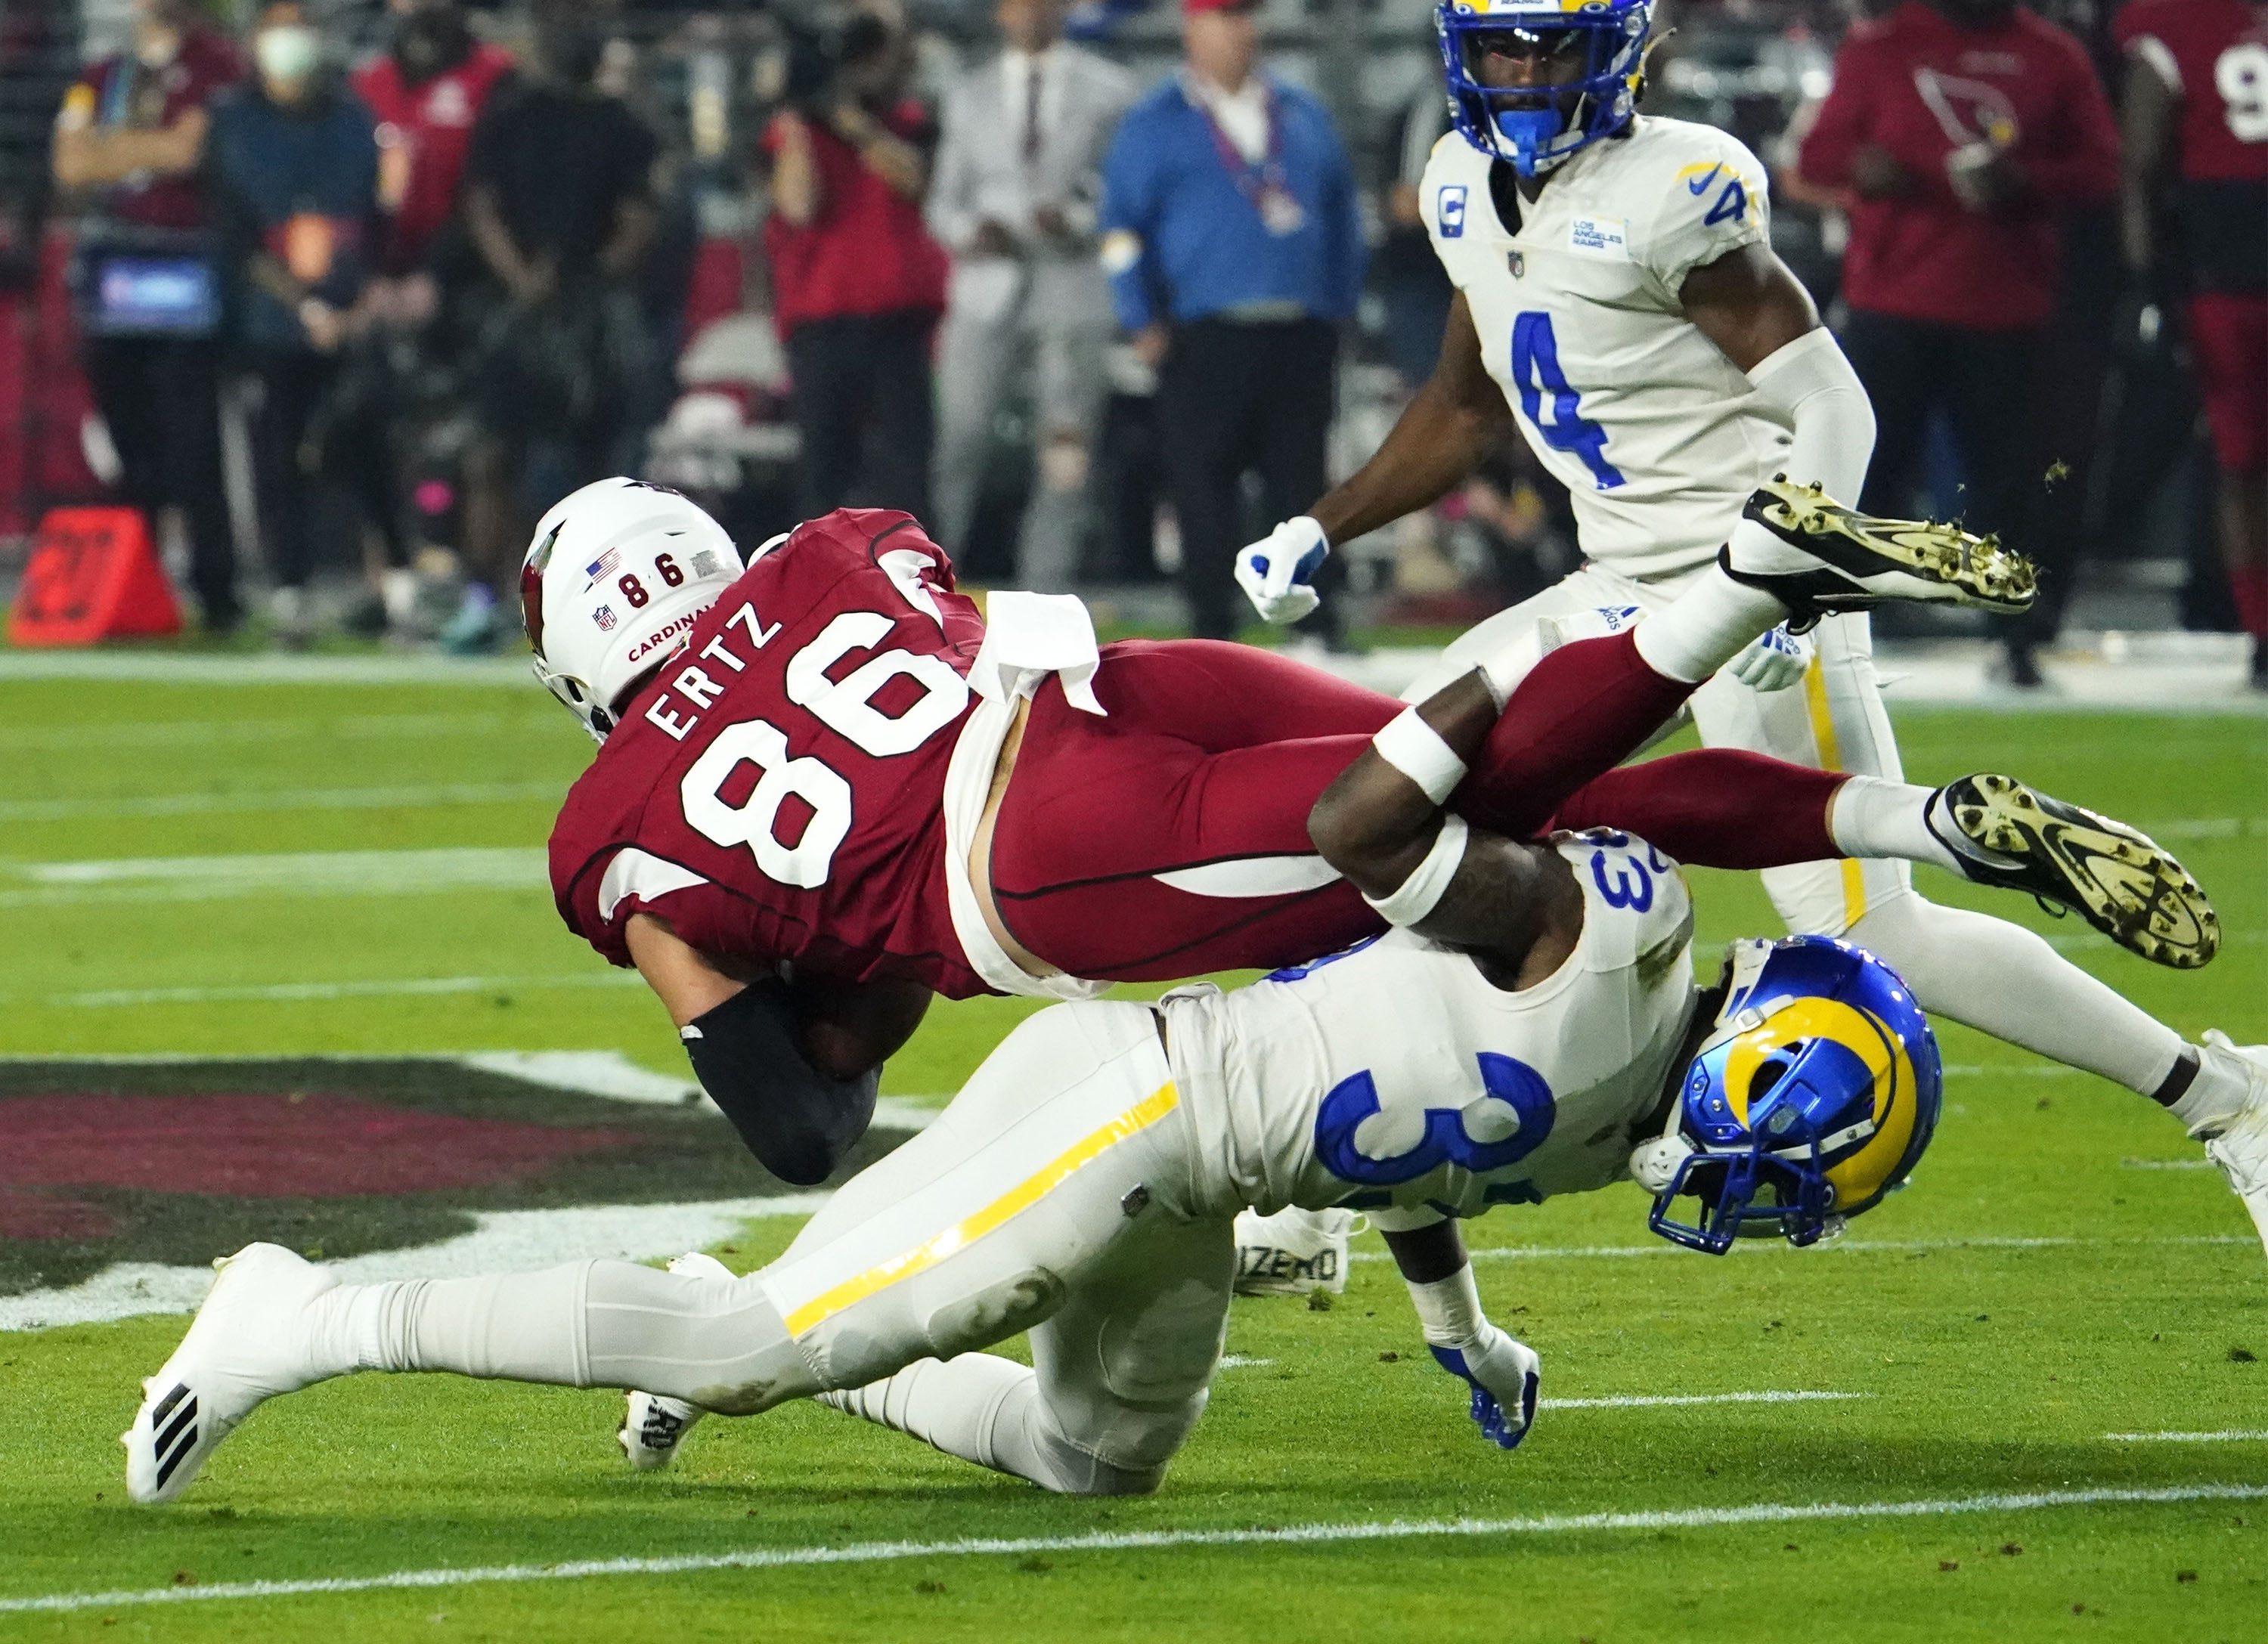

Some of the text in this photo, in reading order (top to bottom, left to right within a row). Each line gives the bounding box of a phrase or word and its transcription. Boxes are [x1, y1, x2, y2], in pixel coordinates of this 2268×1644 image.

[1574, 220, 1594, 230] LOS
[1574, 229, 1622, 243] ANGELES
[1703, 180, 1747, 225] 4
[1573, 237, 1604, 248] RAMS
[1511, 311, 1626, 490] 4
[628, 600, 718, 662] CARDINA
[644, 602, 782, 742] ERTZ
[680, 611, 969, 890] 86
[1580, 833, 1653, 913] 3
[1315, 1051, 1556, 1218] 3
